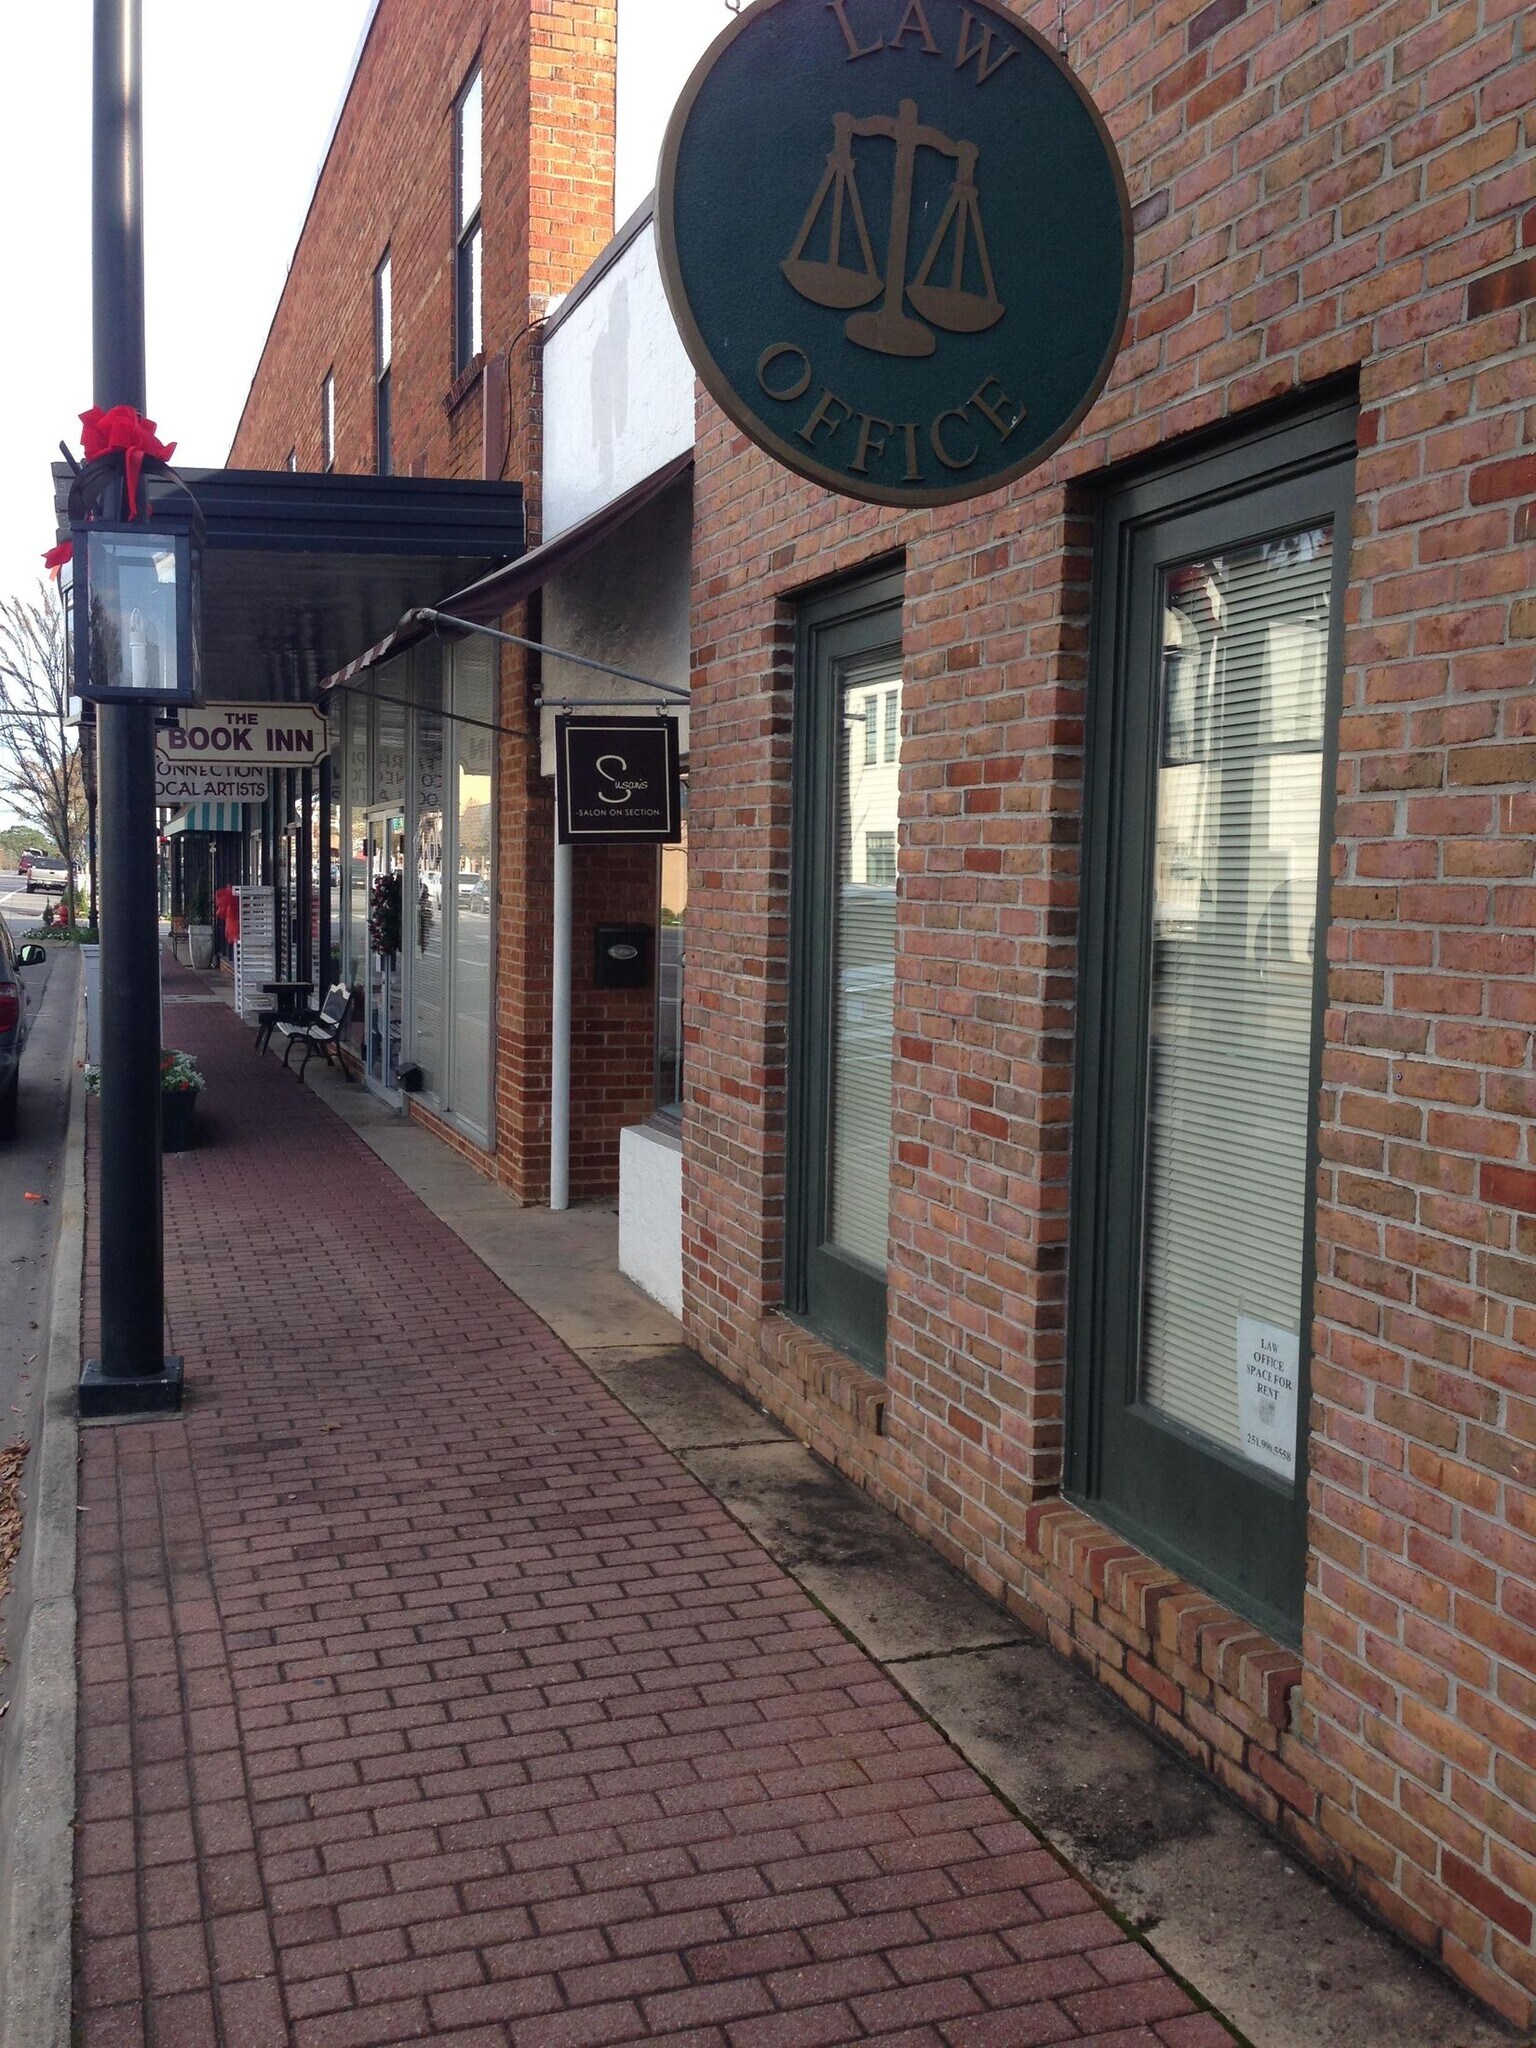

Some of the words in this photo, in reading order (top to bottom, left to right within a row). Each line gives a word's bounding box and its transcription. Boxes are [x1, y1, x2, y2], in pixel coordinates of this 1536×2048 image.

[825, 0, 1020, 86] LAW
[757, 341, 1028, 481] OFFICE
[224, 713, 258, 725] THE
[168, 726, 253, 751] BOOK
[266, 728, 314, 752] INN
[156, 762, 263, 778] ONNECTION
[595, 754, 649, 803] Susan's
[155, 781, 200, 796] OCAL
[203, 781, 266, 797] ARTISTS
[609, 808, 623, 816] ON
[1261, 1338, 1279, 1354] LAW
[1253, 1351, 1285, 1372] OFFICE
[1246, 1363, 1273, 1383] SPACE
[1273, 1374, 1293, 1391] FOR
[1257, 1382, 1280, 1400] RENT
